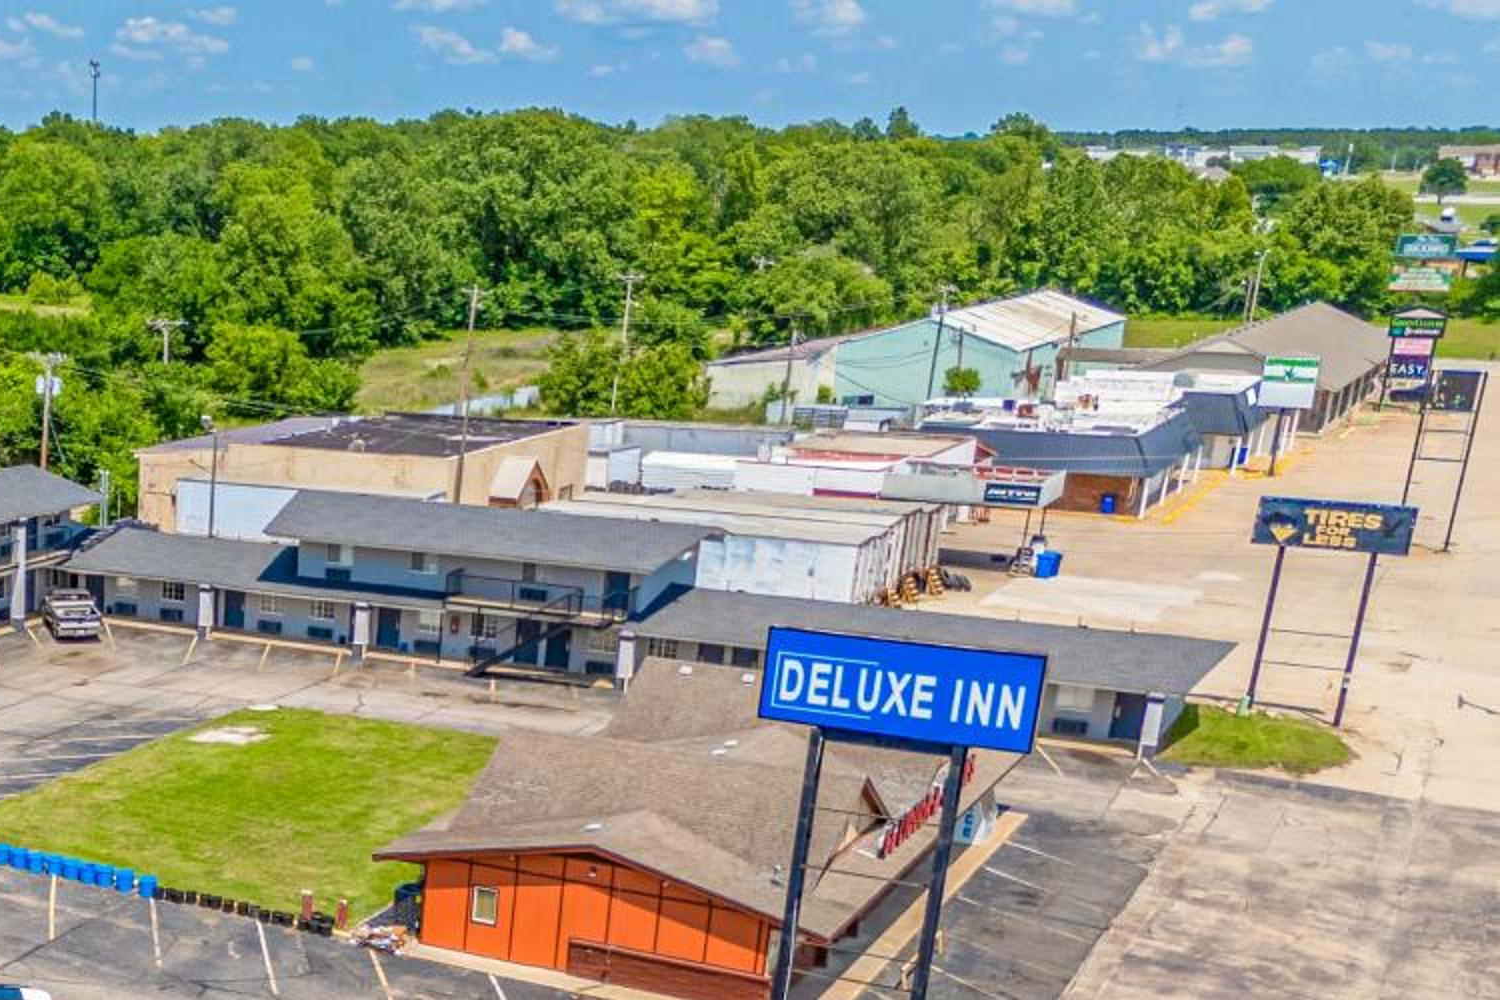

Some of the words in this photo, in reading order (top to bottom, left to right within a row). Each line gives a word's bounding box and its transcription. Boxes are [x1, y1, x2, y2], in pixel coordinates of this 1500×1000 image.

[1304, 508, 1383, 529] TIRES
[1315, 526, 1350, 536] FOR
[1303, 533, 1357, 547] LESS
[778, 658, 937, 719] DELUXE
[950, 679, 1026, 730] INN
